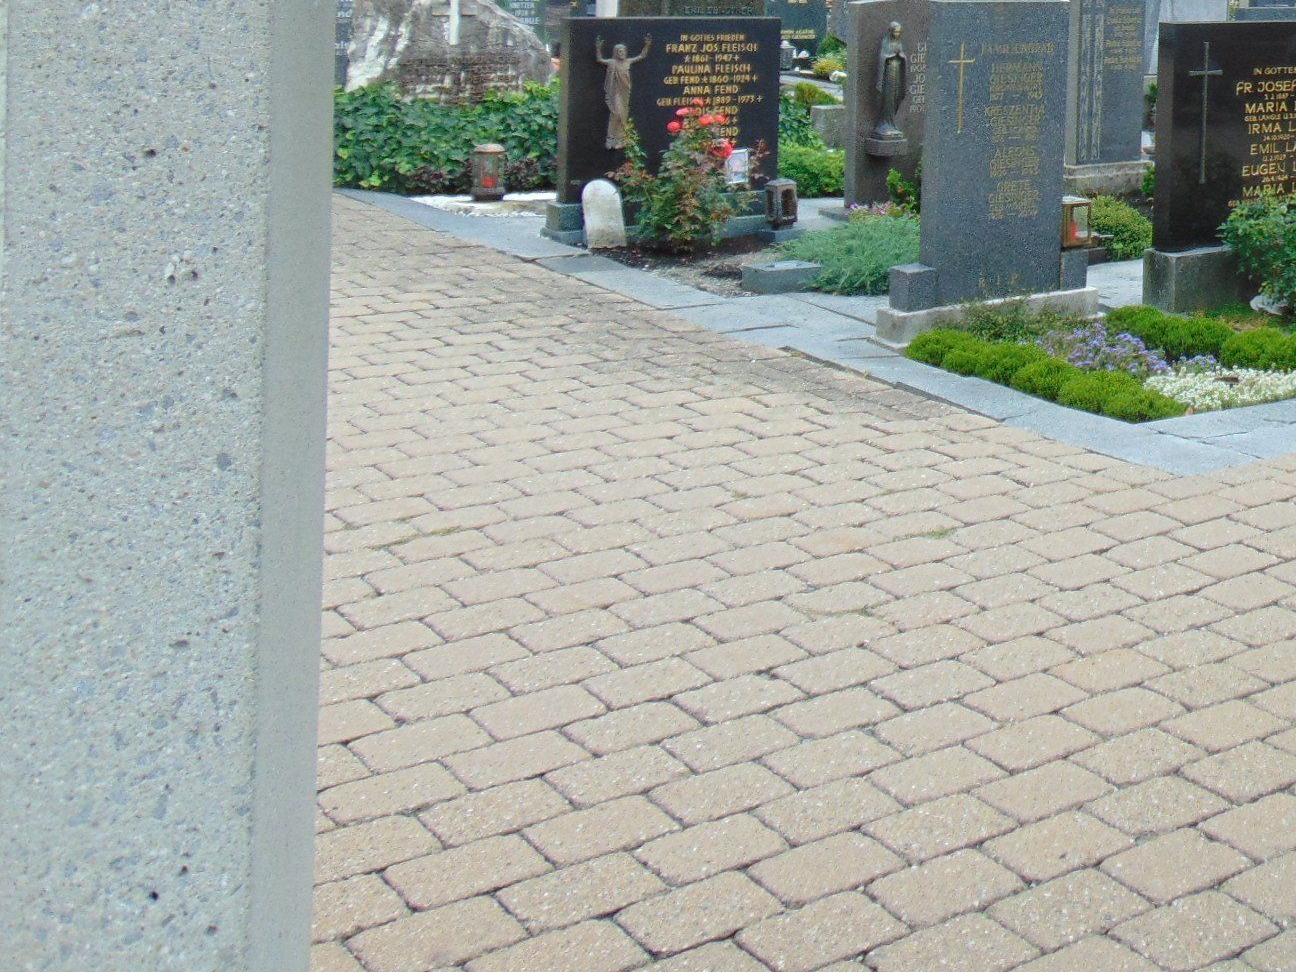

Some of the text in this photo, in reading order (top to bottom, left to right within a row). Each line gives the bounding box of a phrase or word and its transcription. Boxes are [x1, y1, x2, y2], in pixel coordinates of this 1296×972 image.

[665, 42, 758, 53] FRANZ JOS FLEISCH
[671, 64, 751, 74] PAULINA FLEISCH
[1253, 67, 1262, 75] IN
[683, 85, 739, 95] ANNA FEND
[1245, 101, 1288, 114] MARIA
[1248, 122, 1282, 135] IRMA
[1250, 143, 1280, 155] EMIL
[1242, 162, 1286, 177] EUGEN
[1241, 183, 1286, 197] MARIA
